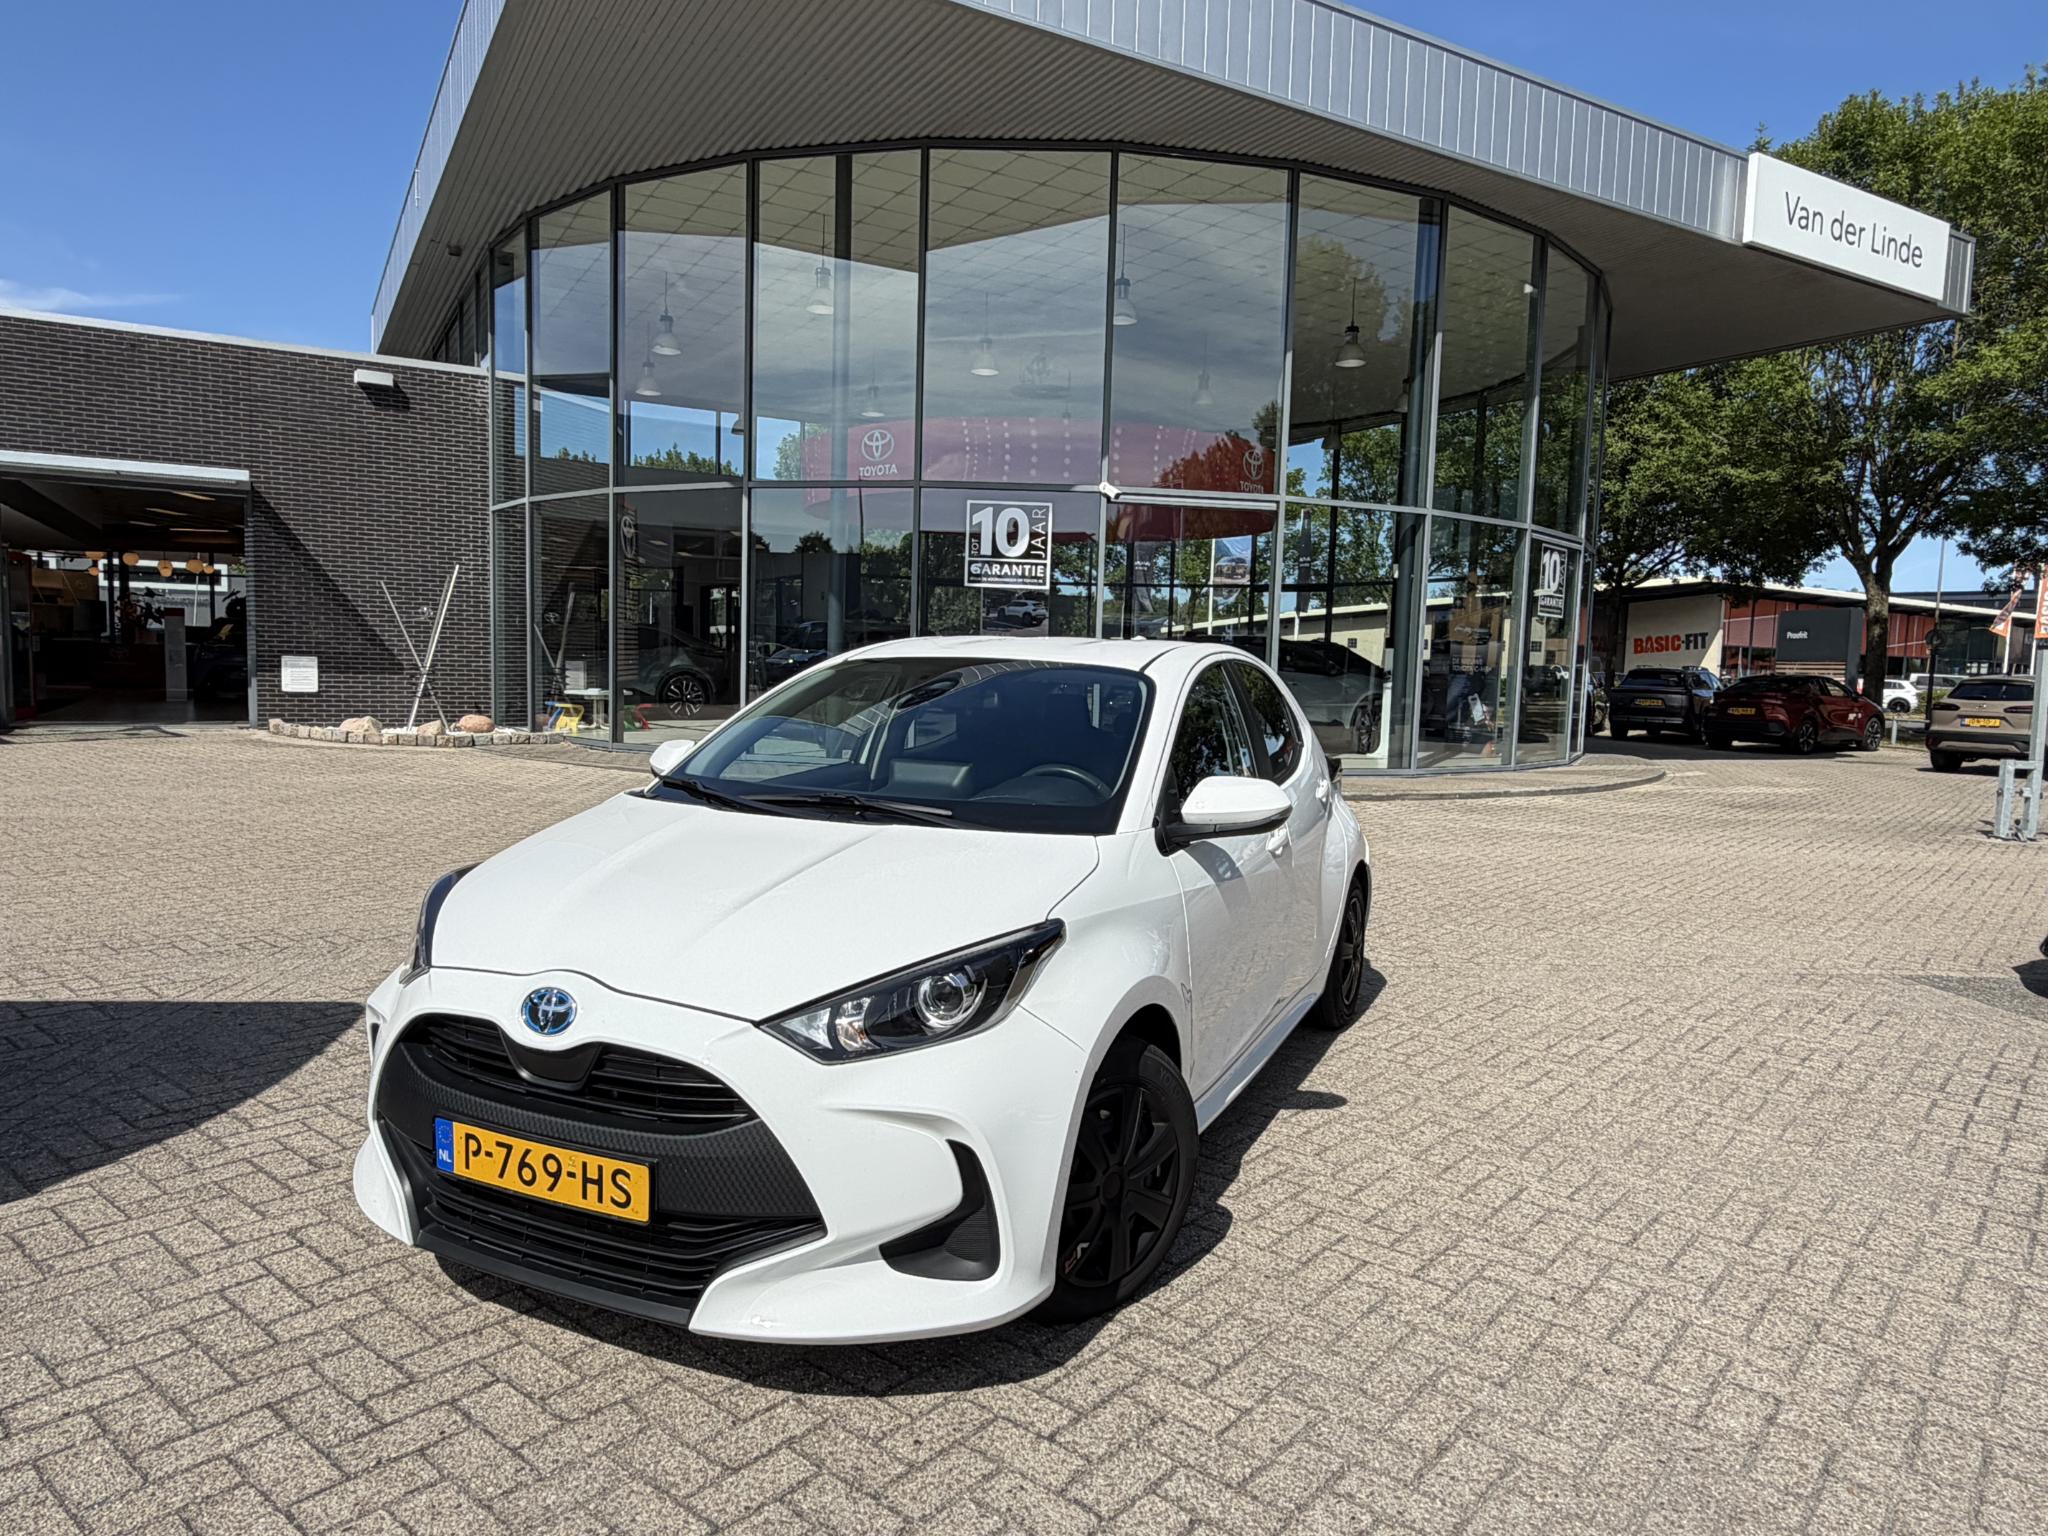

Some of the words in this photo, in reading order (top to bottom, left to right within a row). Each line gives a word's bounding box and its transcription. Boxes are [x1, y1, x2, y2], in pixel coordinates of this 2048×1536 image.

[1785, 191, 1823, 236] Van
[1830, 210, 1866, 248] der
[1871, 222, 1924, 268] Linde
[859, 463, 898, 477] TOYOTA
[971, 538, 980, 554] TOT
[972, 506, 1030, 558] 10
[1030, 508, 1047, 558] JAAR
[970, 563, 1045, 577] GARANTIE
[1543, 550, 1561, 592] 10
[438, 1148, 453, 1163] NL
[464, 1132, 632, 1209] P-769-HS
